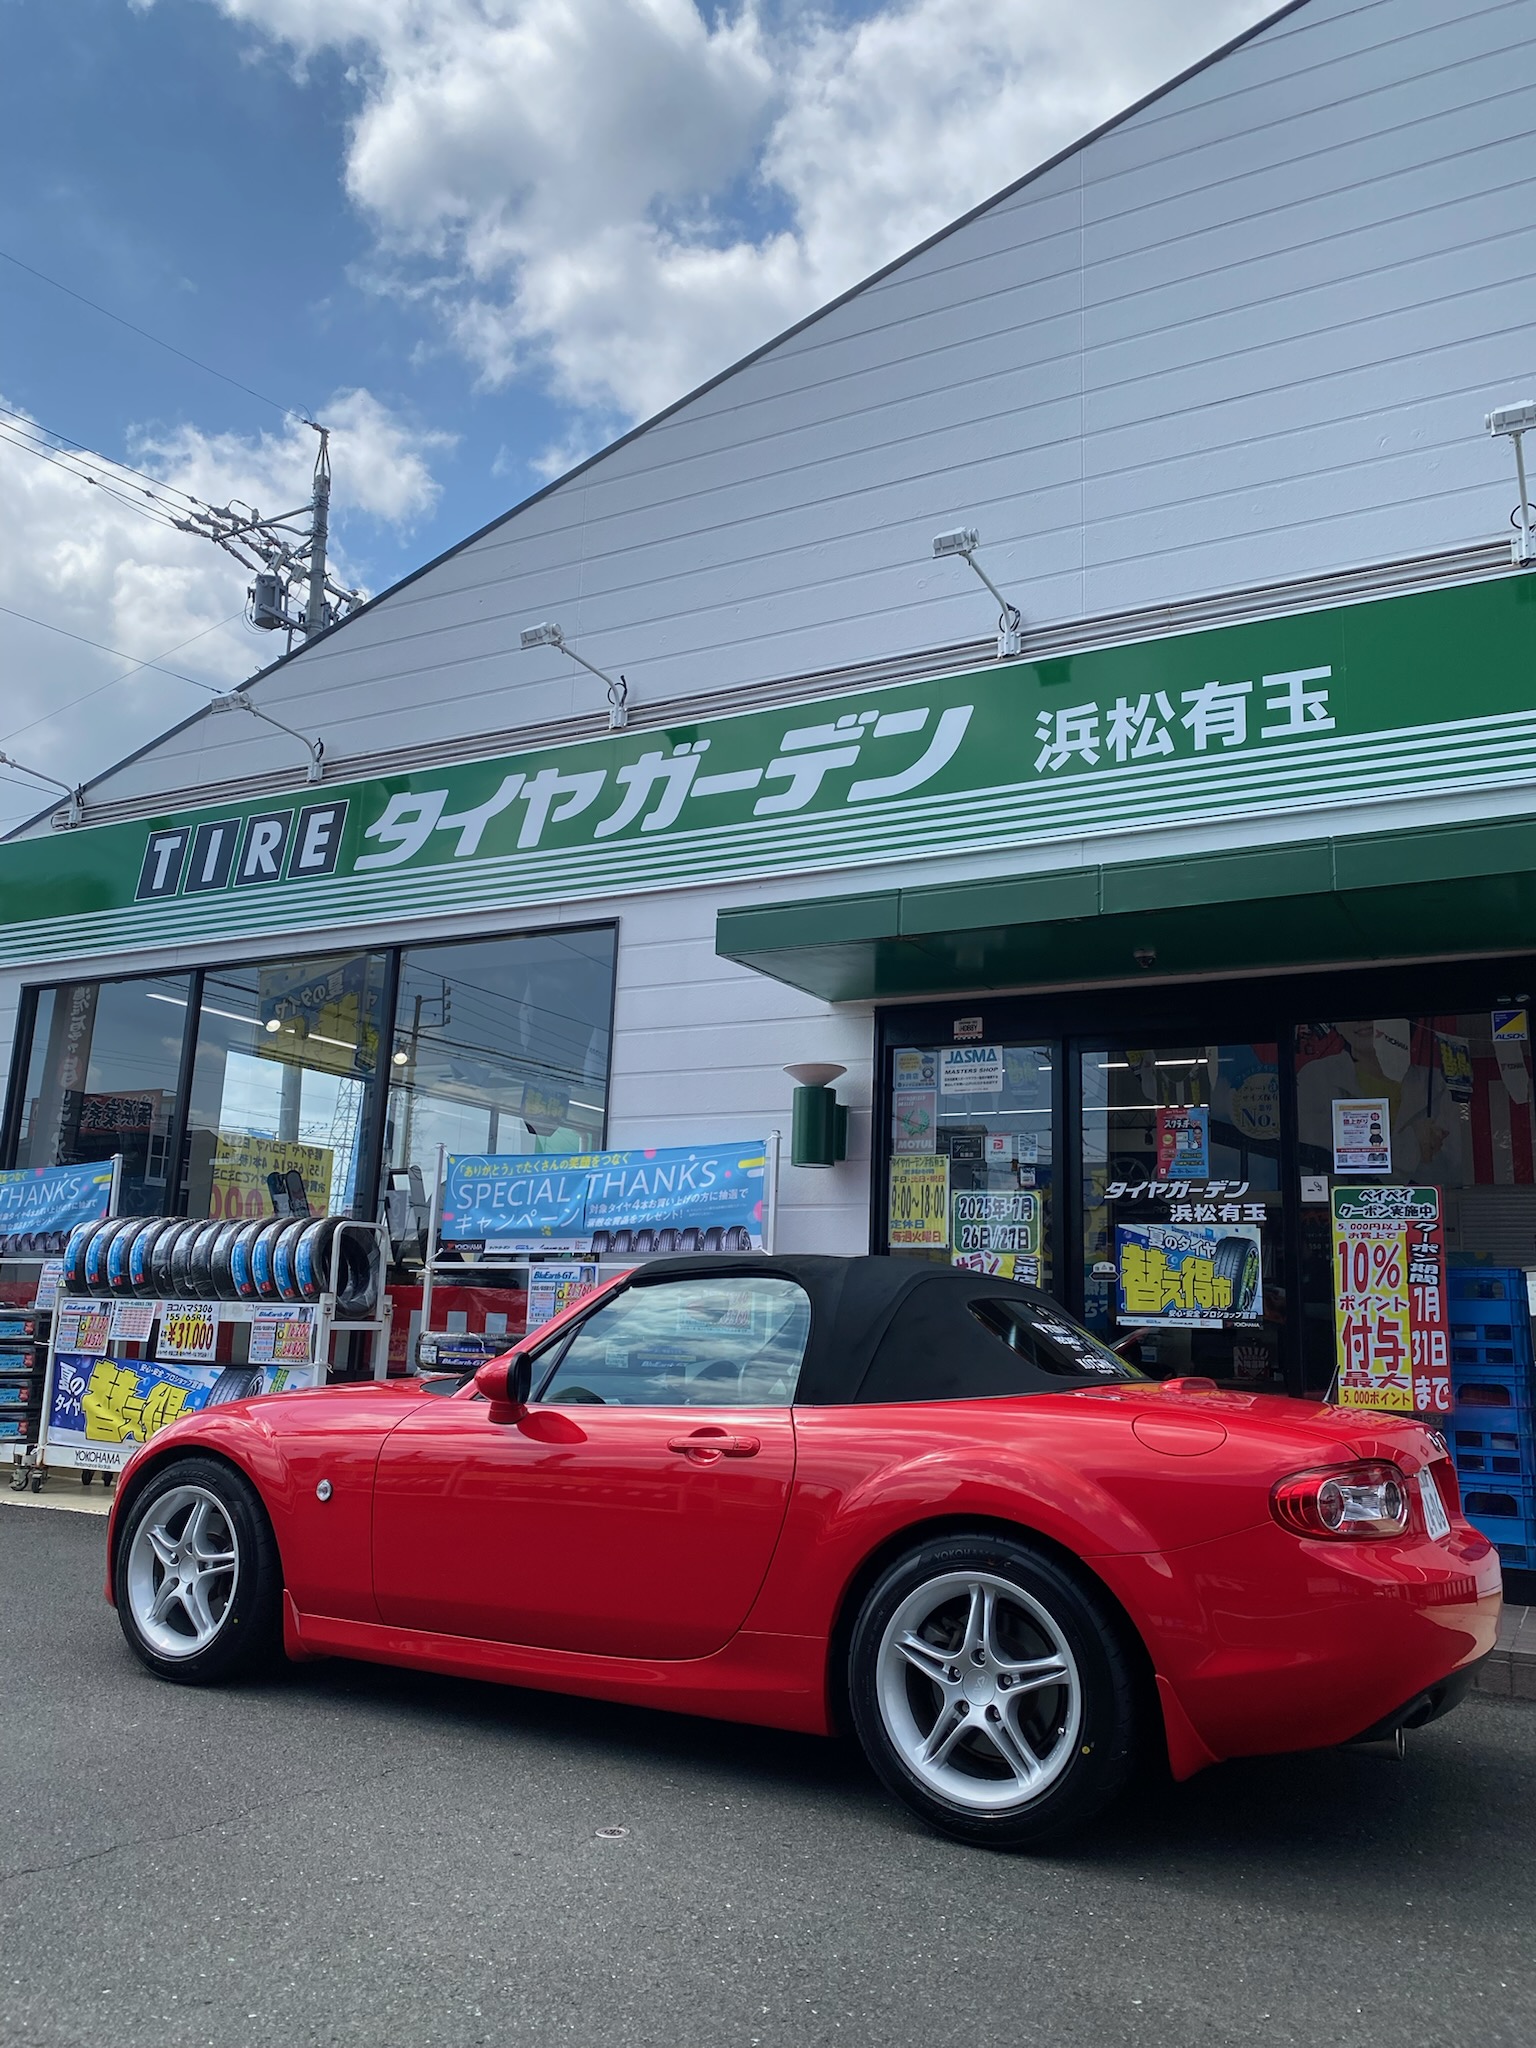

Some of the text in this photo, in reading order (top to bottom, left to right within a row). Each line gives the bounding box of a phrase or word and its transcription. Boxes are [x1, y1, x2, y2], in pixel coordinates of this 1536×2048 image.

[151, 665, 1336, 890] TIRE タイヤガーデン 浜松有玉
[945, 1048, 998, 1065] JASMA
[898, 1140, 934, 1149] MOTUL
[0, 1177, 82, 1208] THANKS
[456, 1160, 719, 1210] SPECIAL THANKS
[1104, 1180, 1249, 1199] タイヤガーデン
[1360, 1189, 1412, 1202] ペイペイ
[455, 1208, 580, 1235] キャンペーン
[1170, 1203, 1267, 1222] 浜松有玉
[1341, 1205, 1433, 1217] クーポン実施中
[892, 1230, 942, 1243] 毎週火曜日
[1148, 1227, 1217, 1258] 夏のタイヤ
[1409, 1222, 1440, 1285] クーポン期間
[534, 1271, 574, 1280] BluEarth-GT
[1120, 1242, 1234, 1313] 替え得市
[1339, 1242, 1400, 1293] 10%
[167, 1303, 213, 1313] ヨコハマS306
[1340, 1296, 1408, 1311] ポイント
[1414, 1286, 1441, 1322] 7月
[165, 1313, 212, 1322] 155/65R14
[167, 1321, 214, 1350] ¥31,000
[1342, 1314, 1406, 1372] 付与
[1412, 1330, 1447, 1366] 31日
[58, 1361, 86, 1396] 夏の
[1340, 1372, 1409, 1389] 最大
[55, 1394, 81, 1417] タイヤ
[1415, 1376, 1450, 1411] まで
[75, 1450, 121, 1465] YOKOHAMA
